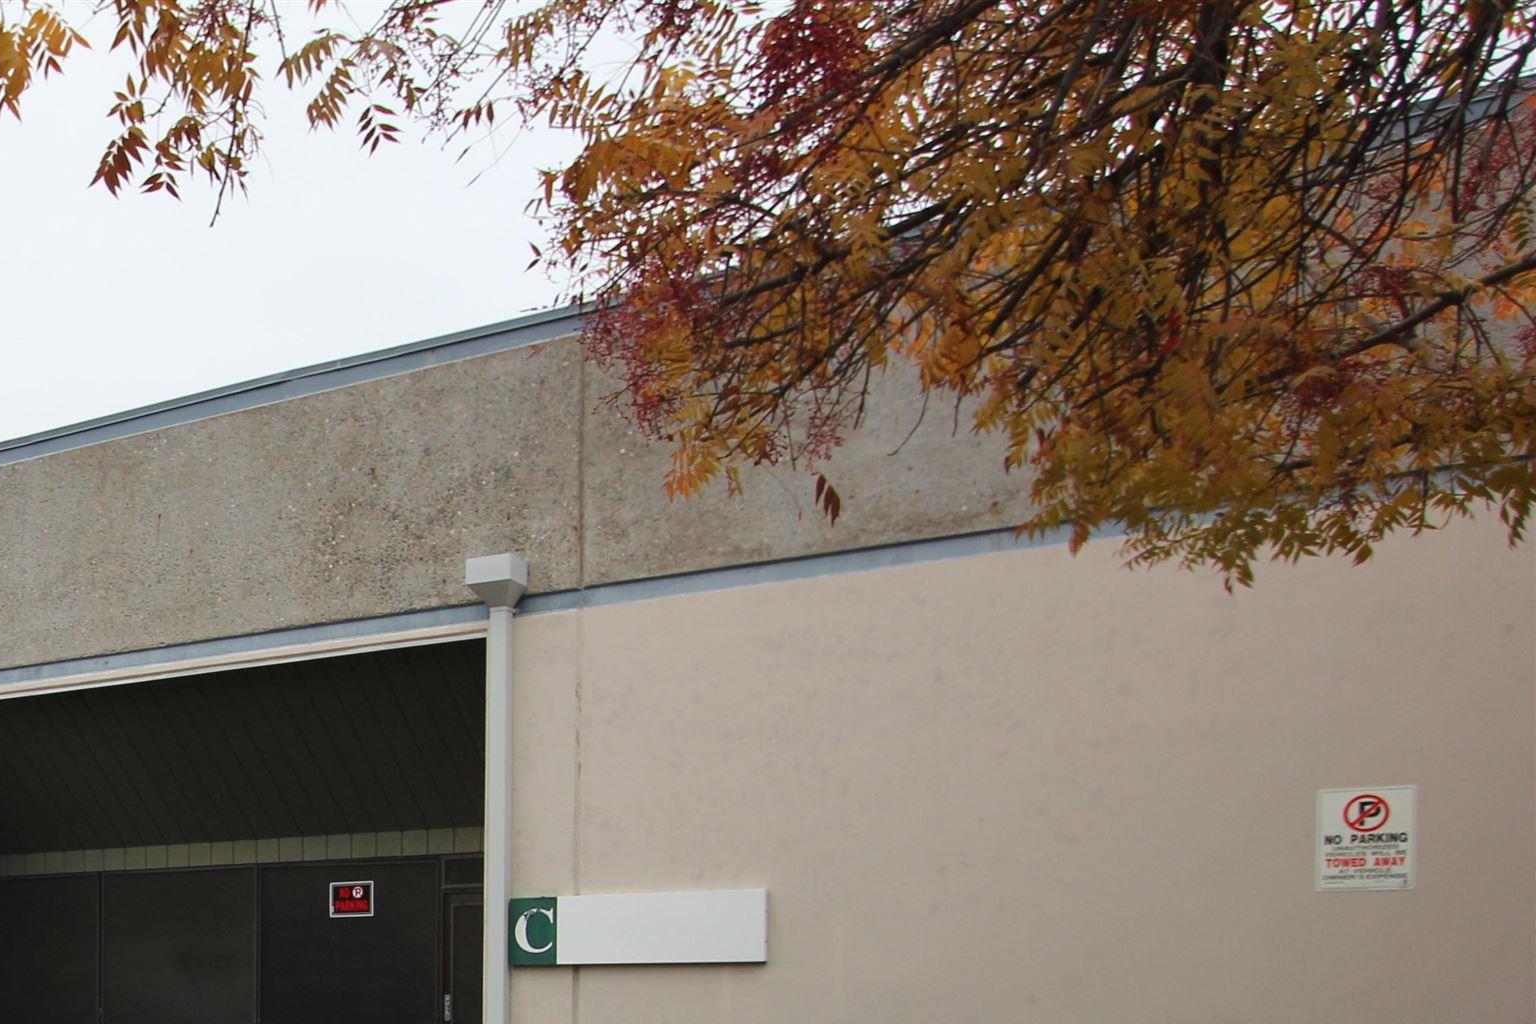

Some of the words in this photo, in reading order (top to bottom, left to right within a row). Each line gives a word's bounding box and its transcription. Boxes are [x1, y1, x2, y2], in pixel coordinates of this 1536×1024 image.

[1324, 834, 1342, 845] NO
[1350, 832, 1408, 844] PARKING
[1325, 858, 1367, 868] TOWED
[1373, 856, 1406, 867] AWAY
[514, 907, 554, 954] C
